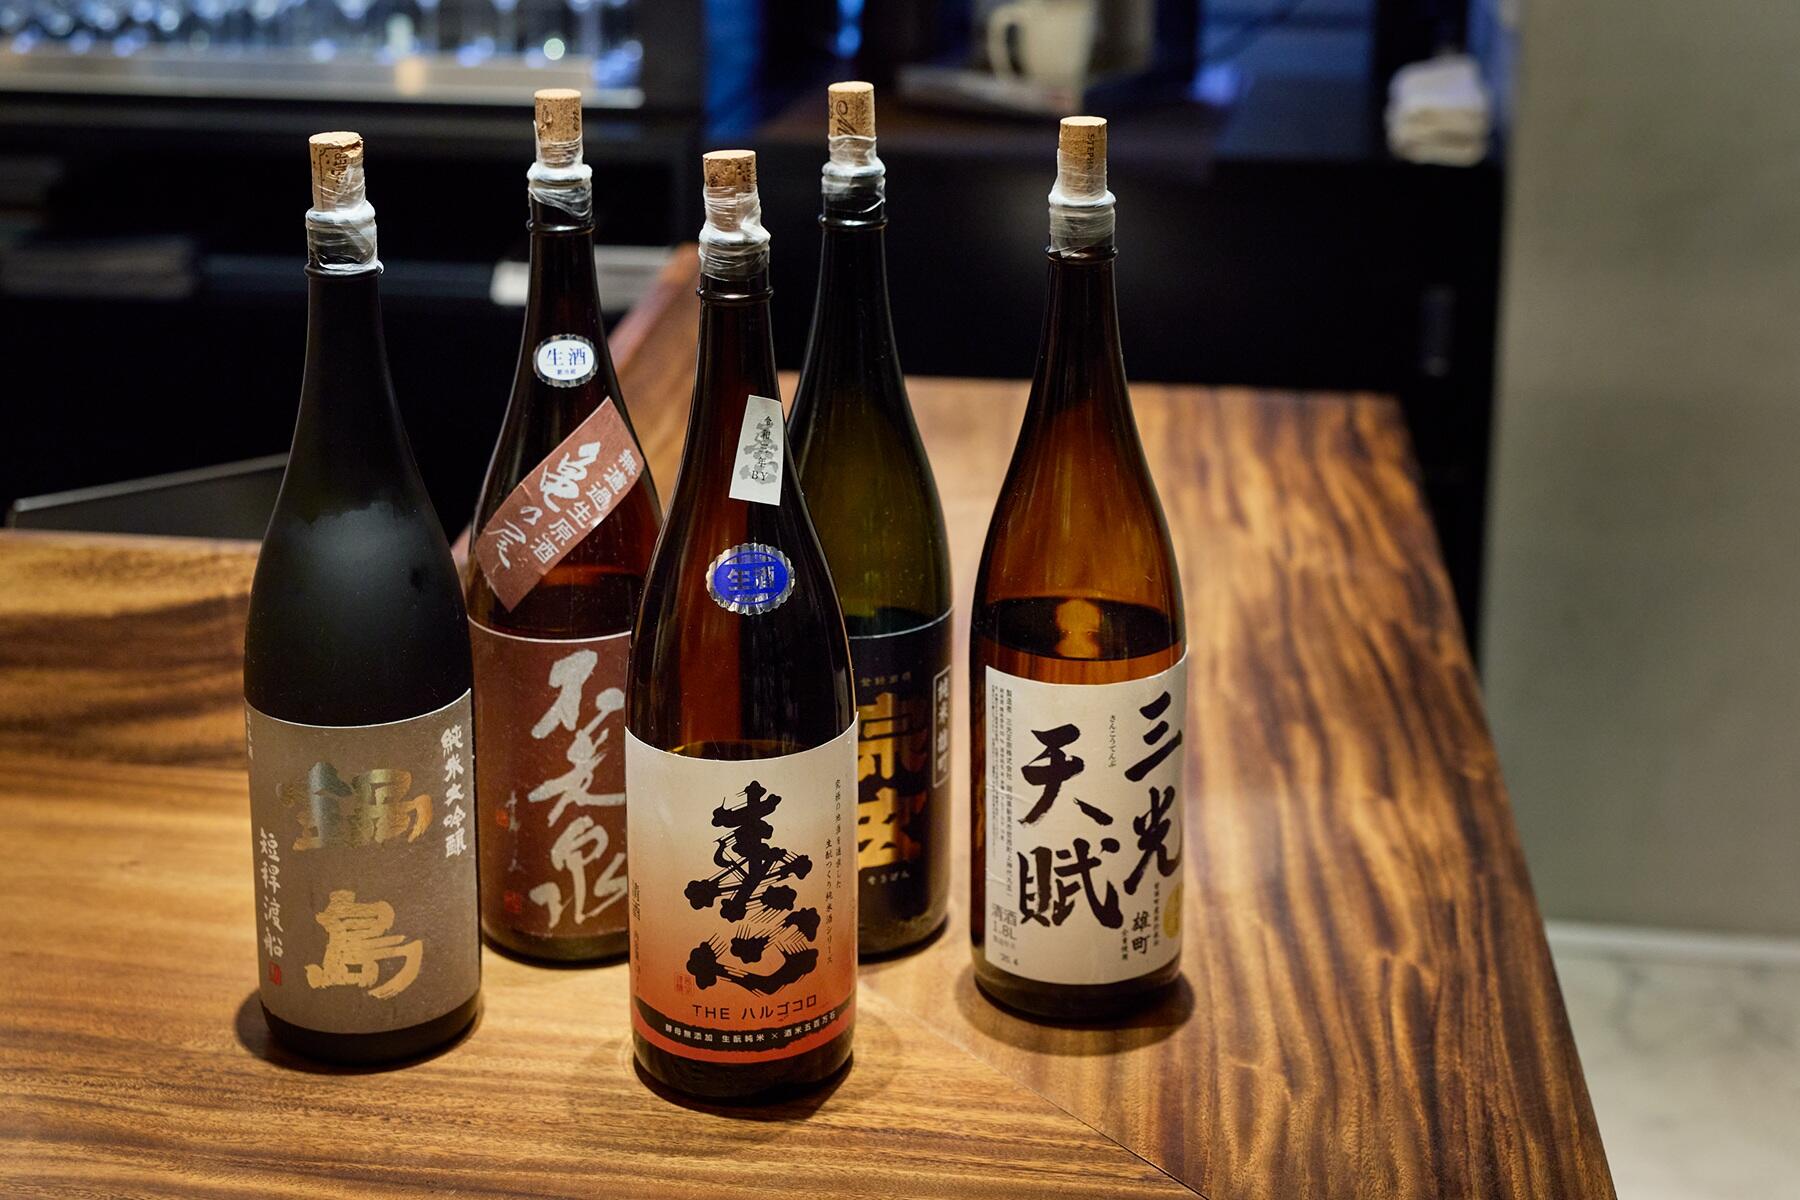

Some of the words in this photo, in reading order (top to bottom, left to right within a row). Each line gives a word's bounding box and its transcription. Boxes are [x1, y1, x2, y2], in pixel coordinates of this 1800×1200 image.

[546, 347, 586, 366] 生酒
[440, 724, 468, 858] 純米大吟醸
[1017, 723, 1124, 929] 天賦
[1124, 691, 1183, 896] 三光
[1131, 911, 1151, 954] 雄町
[692, 1004, 730, 1020] THE
[741, 994, 817, 1022] ハルゴコロ
